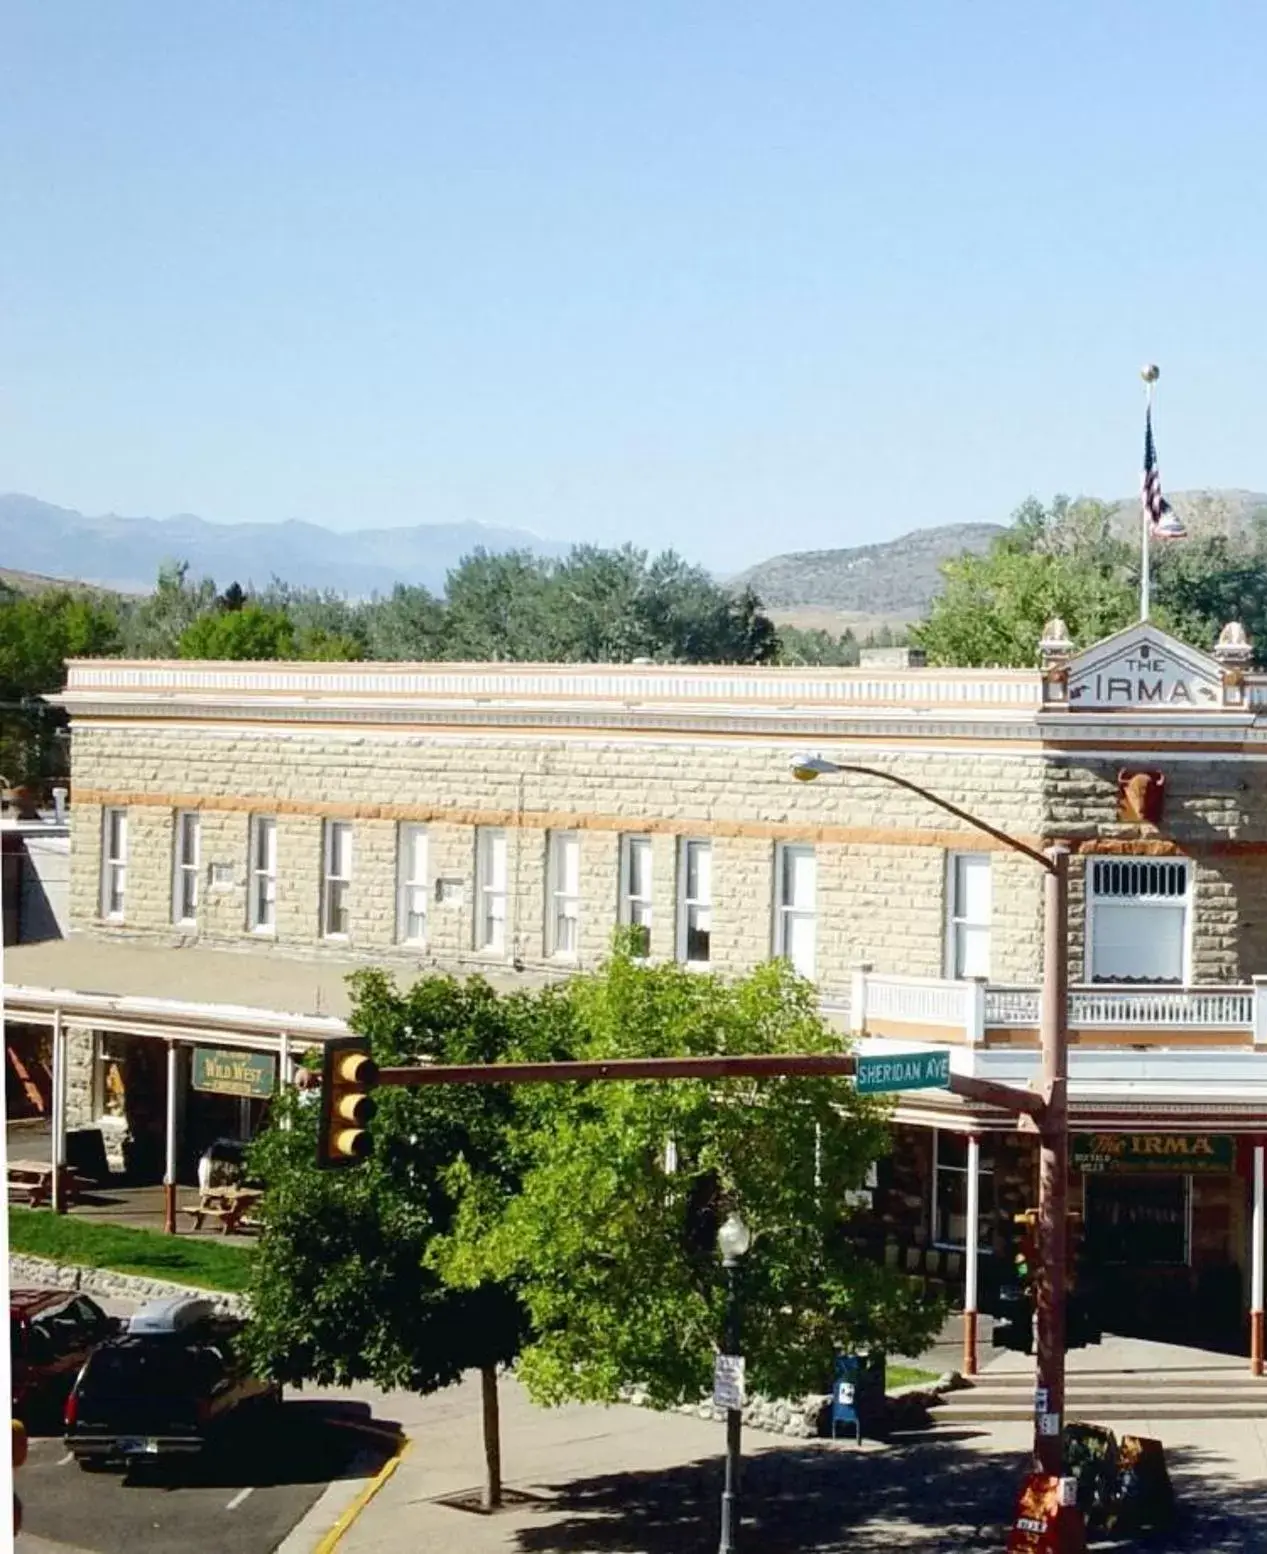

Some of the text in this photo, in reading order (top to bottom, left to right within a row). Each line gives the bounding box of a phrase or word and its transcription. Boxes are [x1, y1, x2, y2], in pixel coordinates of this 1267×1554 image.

[1126, 659, 1165, 672] THE
[1096, 674, 1195, 701] IRMA
[859, 1057, 949, 1085] SHERIDAN AVE
[1131, 1135, 1215, 1155] IRMA
